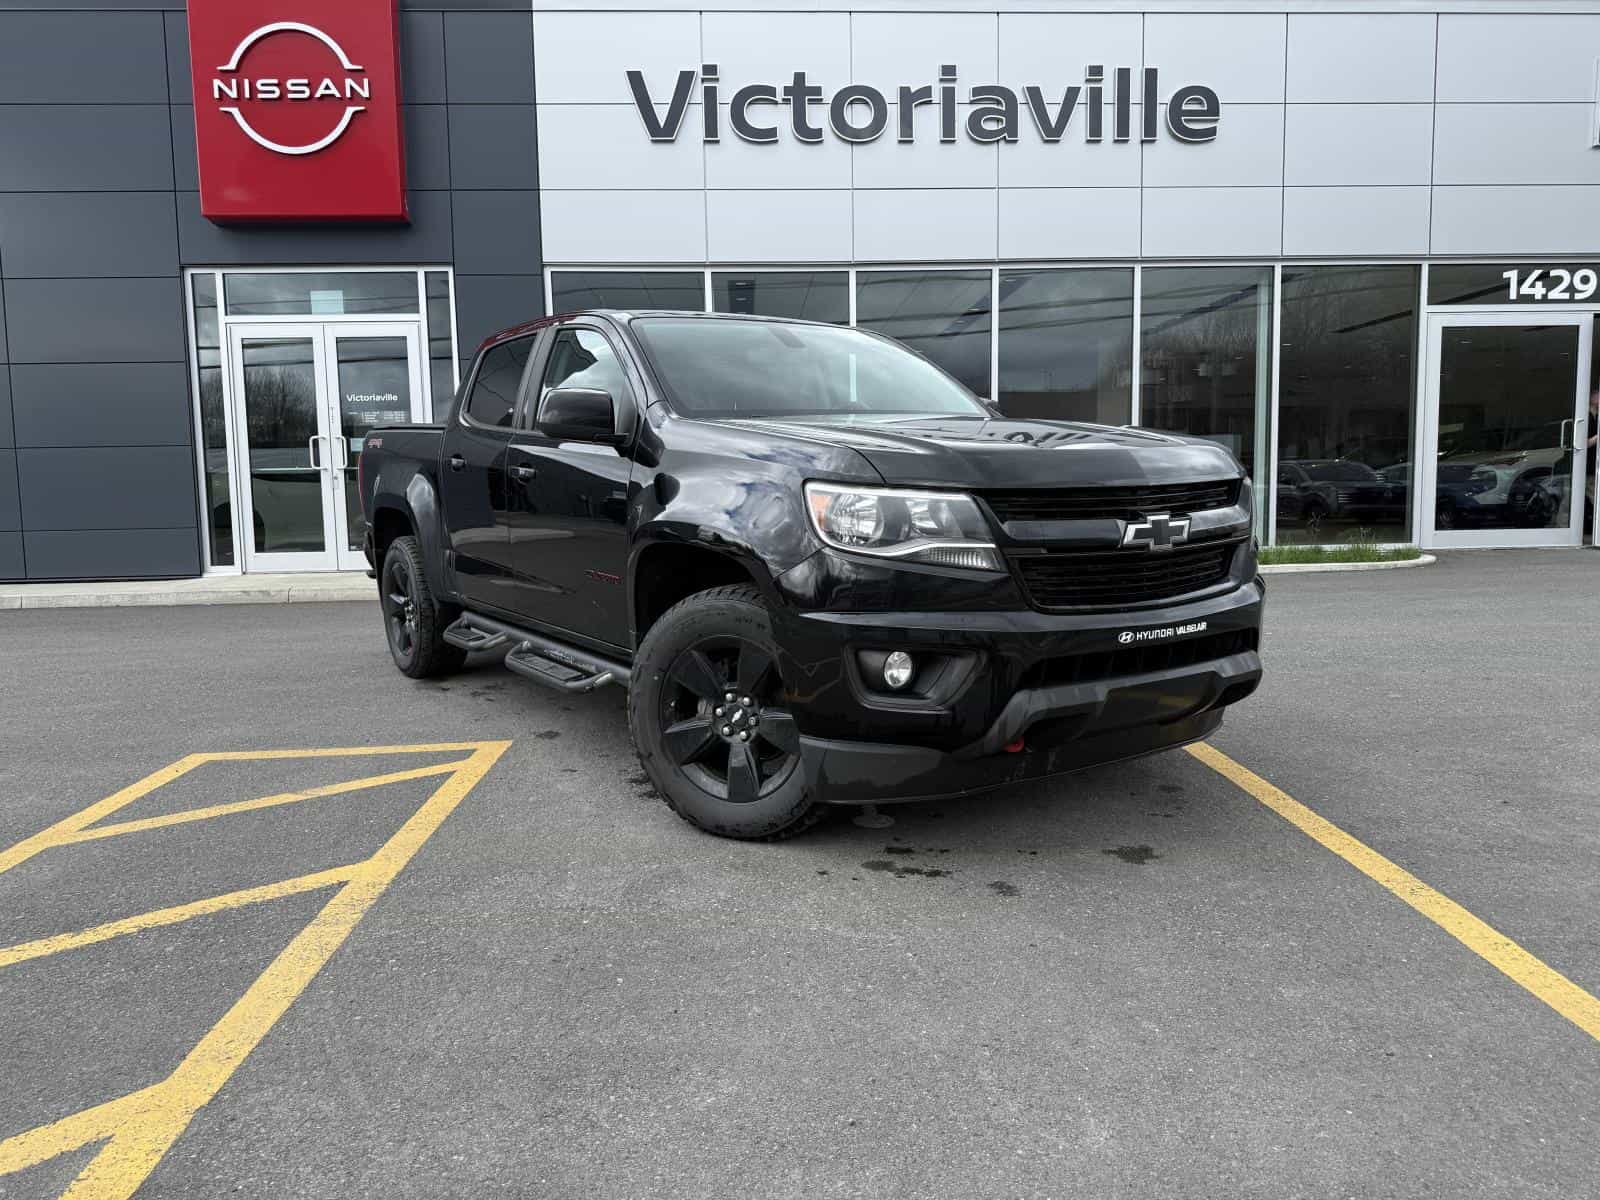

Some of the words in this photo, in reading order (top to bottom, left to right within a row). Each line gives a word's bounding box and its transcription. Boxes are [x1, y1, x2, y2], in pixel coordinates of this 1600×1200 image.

[212, 77, 370, 99] NISSAN
[625, 64, 1221, 144] Victoriaville
[1502, 268, 1598, 300] 1429
[346, 393, 398, 402] Victoriaville
[1136, 628, 1174, 640] HYUNDAI
